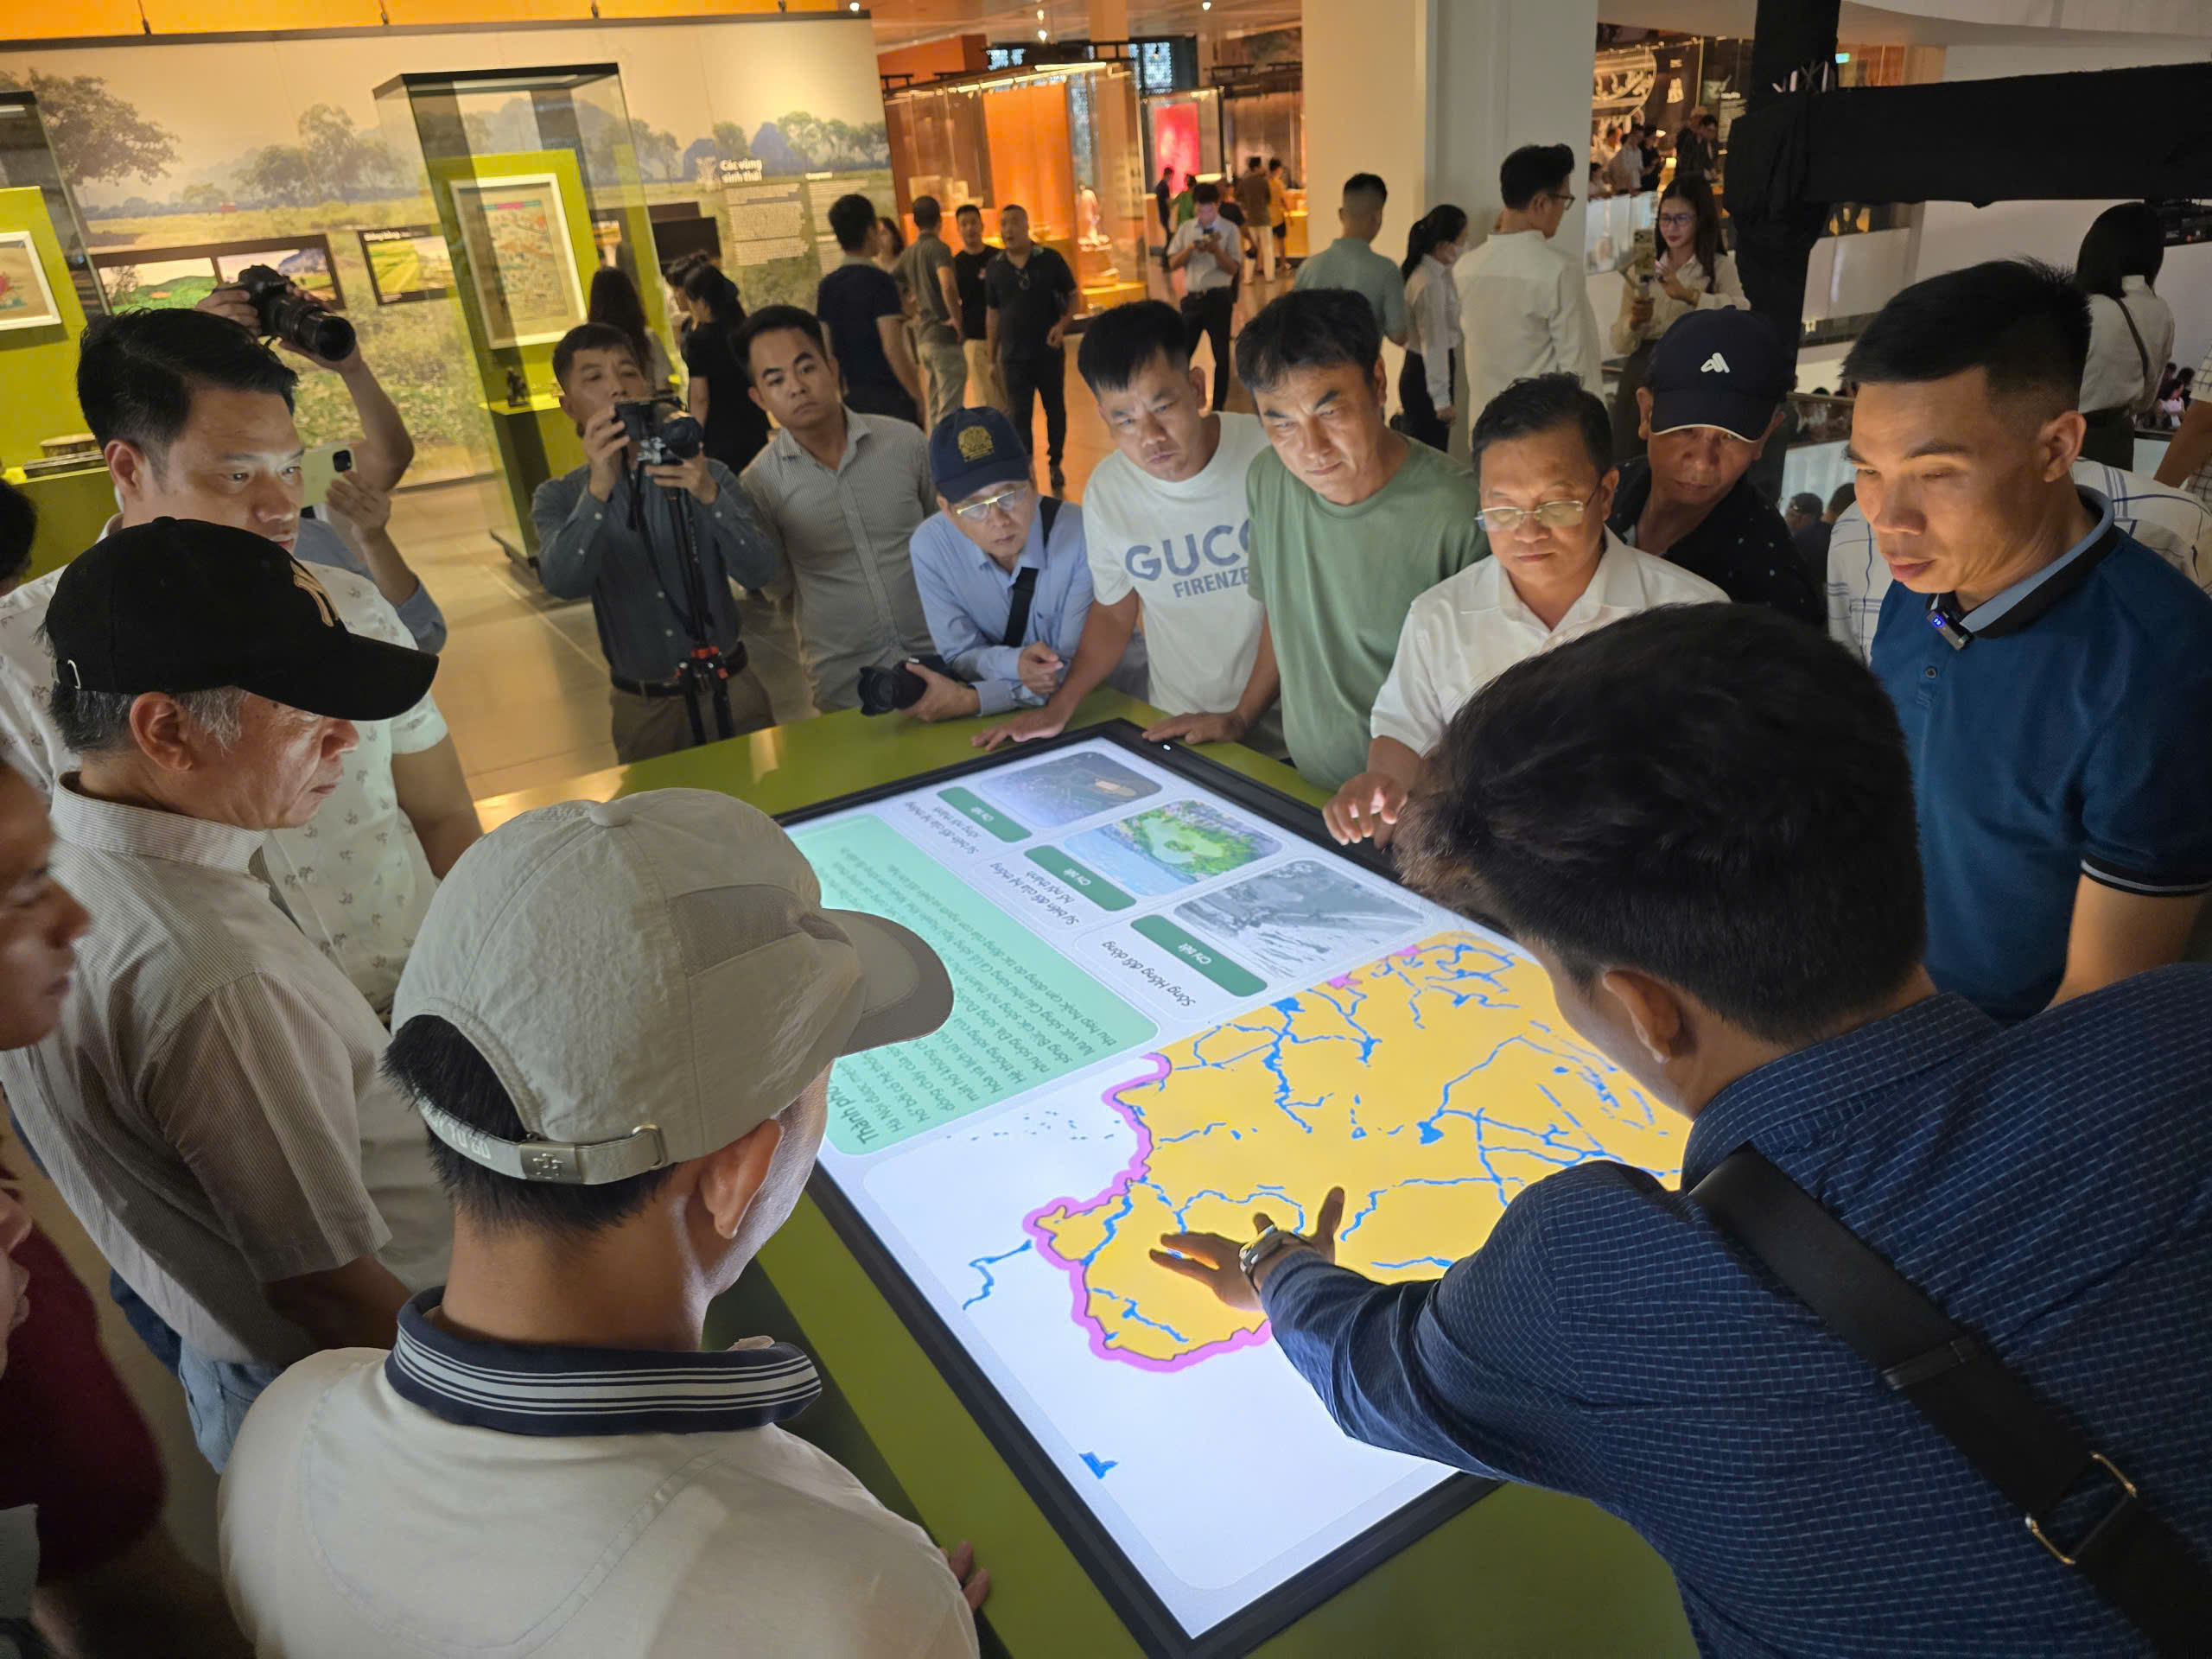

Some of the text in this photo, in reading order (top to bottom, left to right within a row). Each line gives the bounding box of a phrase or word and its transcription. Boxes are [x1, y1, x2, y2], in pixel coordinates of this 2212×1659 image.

[1173, 566, 1249, 599] FIRENZE
[1023, 870, 1052, 887] thành
[1017, 884, 1039, 895] của
[1044, 902, 1069, 918] biến
[1190, 951, 1213, 964] Chi
[988, 969, 1014, 988] sông
[1011, 964, 1029, 976] do
[1099, 939, 1198, 1007] Sông Hồng đổi dòng
[1021, 972, 1051, 992] dòng
[1043, 988, 1065, 1003] cạn
[974, 1008, 1001, 1028] sông
[995, 1001, 1023, 1020] sông
[1057, 1001, 1084, 1020] hoặc
[1015, 1019, 1036, 1033] các
[1038, 1010, 1066, 1030] sông
[1077, 1016, 1102, 1033] hẹp
[963, 1028, 991, 1049] sông
[1058, 1027, 1081, 1043] vực
[1094, 1031, 1118, 1047] thu
[1006, 1036, 1034, 1058] sông
[1045, 1043, 1074, 1064] sông
[1073, 1040, 1096, 1056] lưu
[920, 1047, 954, 1076] không
[982, 1046, 1016, 1072] thống
[1024, 1055, 1052, 1073] như
[968, 1065, 988, 1077] và
[884, 1081, 905, 1094] có
[868, 1101, 895, 1120] Nội
[838, 1106, 880, 1144] Thành
[884, 1116, 906, 1133] Hà
